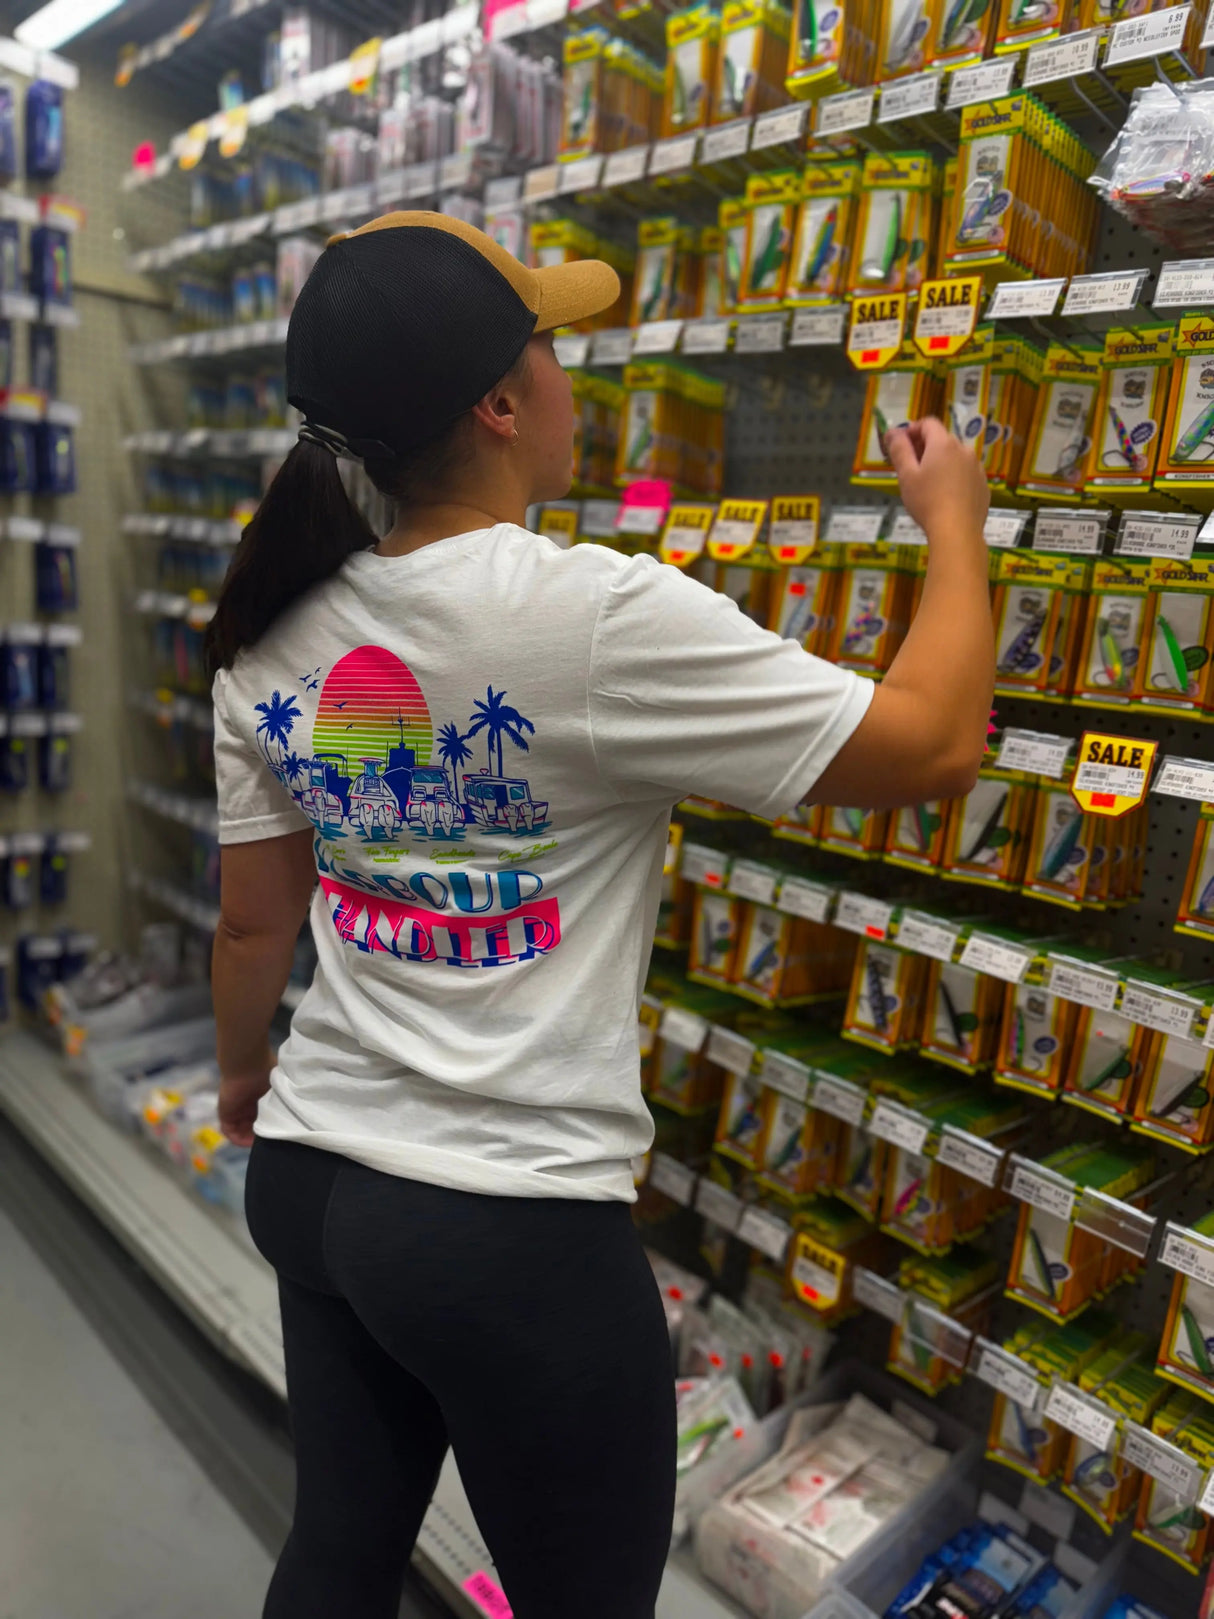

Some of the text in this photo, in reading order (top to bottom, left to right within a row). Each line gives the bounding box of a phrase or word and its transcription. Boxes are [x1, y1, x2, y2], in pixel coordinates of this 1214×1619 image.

[1168, 12, 1184, 24] 6.99
[926, 284, 973, 309] SALE
[857, 299, 899, 323] SALE
[725, 506, 761, 521] SALE
[778, 502, 814, 519] SALE
[1171, 528, 1190, 539] 14.99
[1087, 741, 1145, 769] SALE
